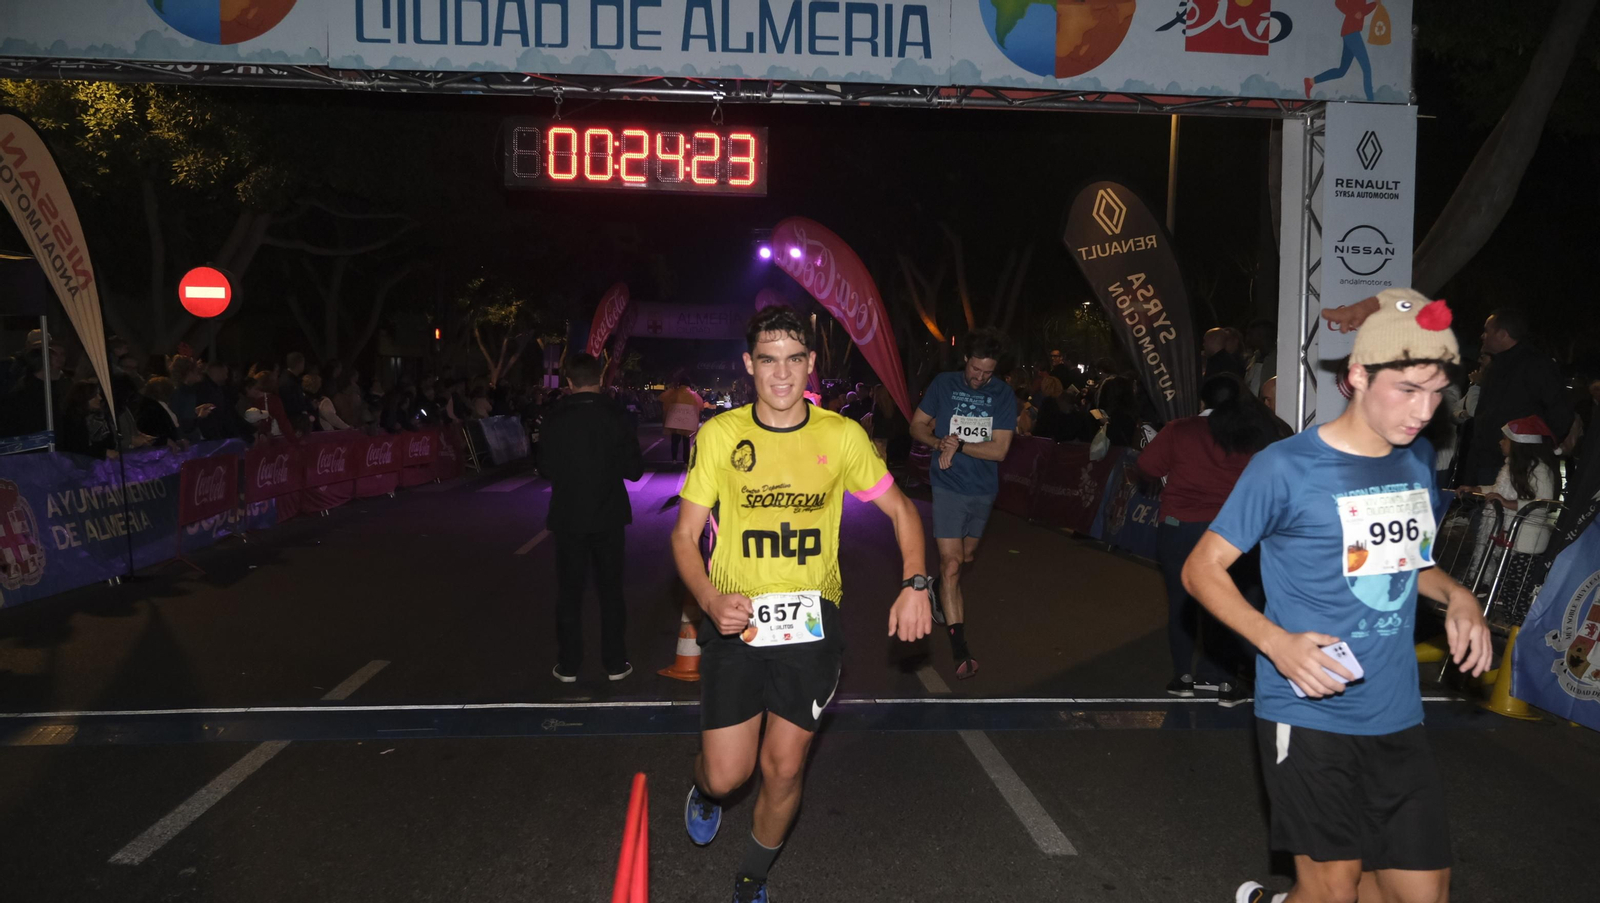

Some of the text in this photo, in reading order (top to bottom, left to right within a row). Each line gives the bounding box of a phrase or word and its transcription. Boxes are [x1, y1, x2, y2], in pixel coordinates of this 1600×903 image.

[356, 0, 932, 59] CIUDAD DE ALMERIA
[548, 127, 755, 185] 00:24:23
[1335, 178, 1401, 190] RENAULT
[1335, 190, 1399, 200] SYRSA AUTOMOCION
[1334, 245, 1395, 256] NISSAN
[1340, 278, 1392, 287] andalmotor.es
[956, 425, 988, 437] 1046
[47, 478, 167, 518] AYUNTAMIENTO
[745, 492, 826, 508] SPORTGYM
[51, 522, 82, 550] DE
[86, 504, 153, 543] ALMERÍA
[1369, 518, 1419, 546] 996
[742, 522, 821, 565] mtp
[758, 602, 802, 623] 657
[1566, 605, 1578, 624] NOBLE
[1566, 682, 1591, 695] CIUDAD
